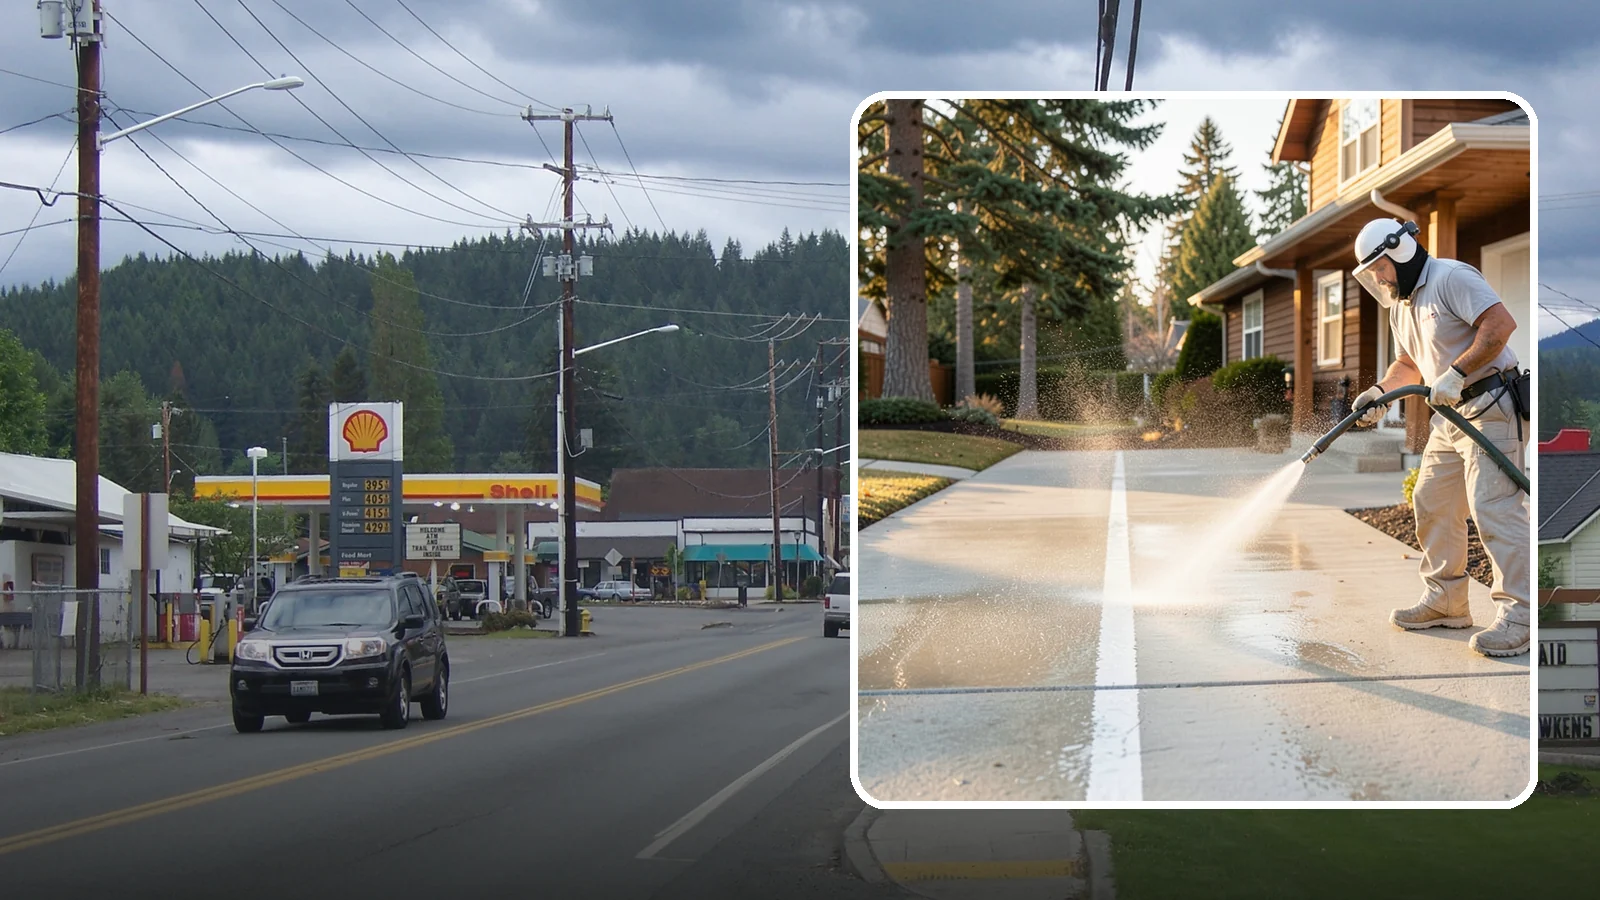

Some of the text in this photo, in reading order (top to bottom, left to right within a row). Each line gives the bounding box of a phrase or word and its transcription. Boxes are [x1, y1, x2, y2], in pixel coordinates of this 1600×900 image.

[366, 480, 384, 490] 395
[490, 484, 547, 499] Shell
[365, 494, 384, 504] 405
[365, 508, 384, 518] 415
[365, 522, 384, 532] 429
